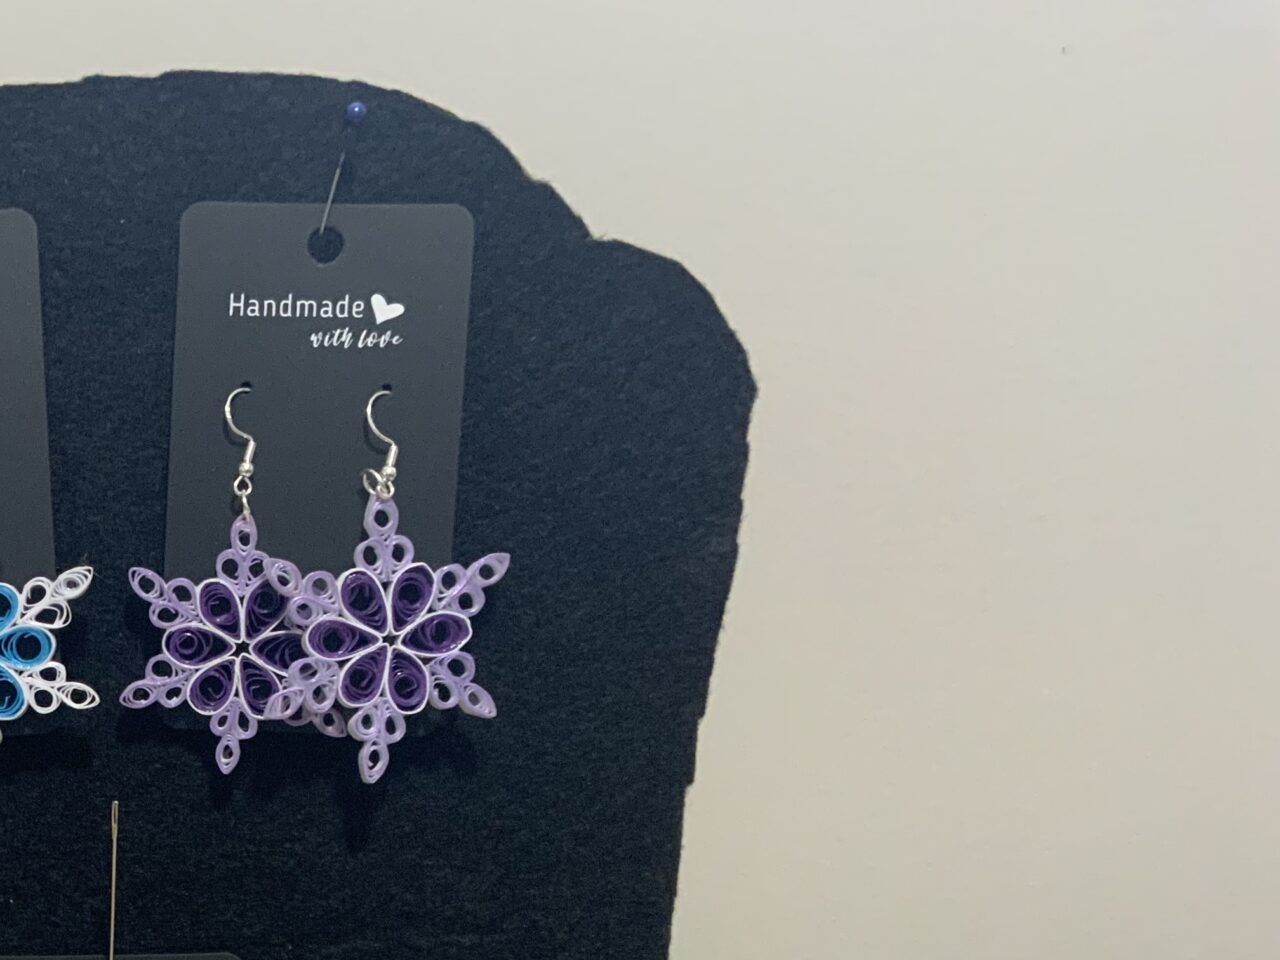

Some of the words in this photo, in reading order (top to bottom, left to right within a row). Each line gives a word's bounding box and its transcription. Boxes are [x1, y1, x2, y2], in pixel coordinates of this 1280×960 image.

[228, 292, 365, 319] Handmade
[309, 326, 354, 349] with
[357, 329, 404, 349] love
